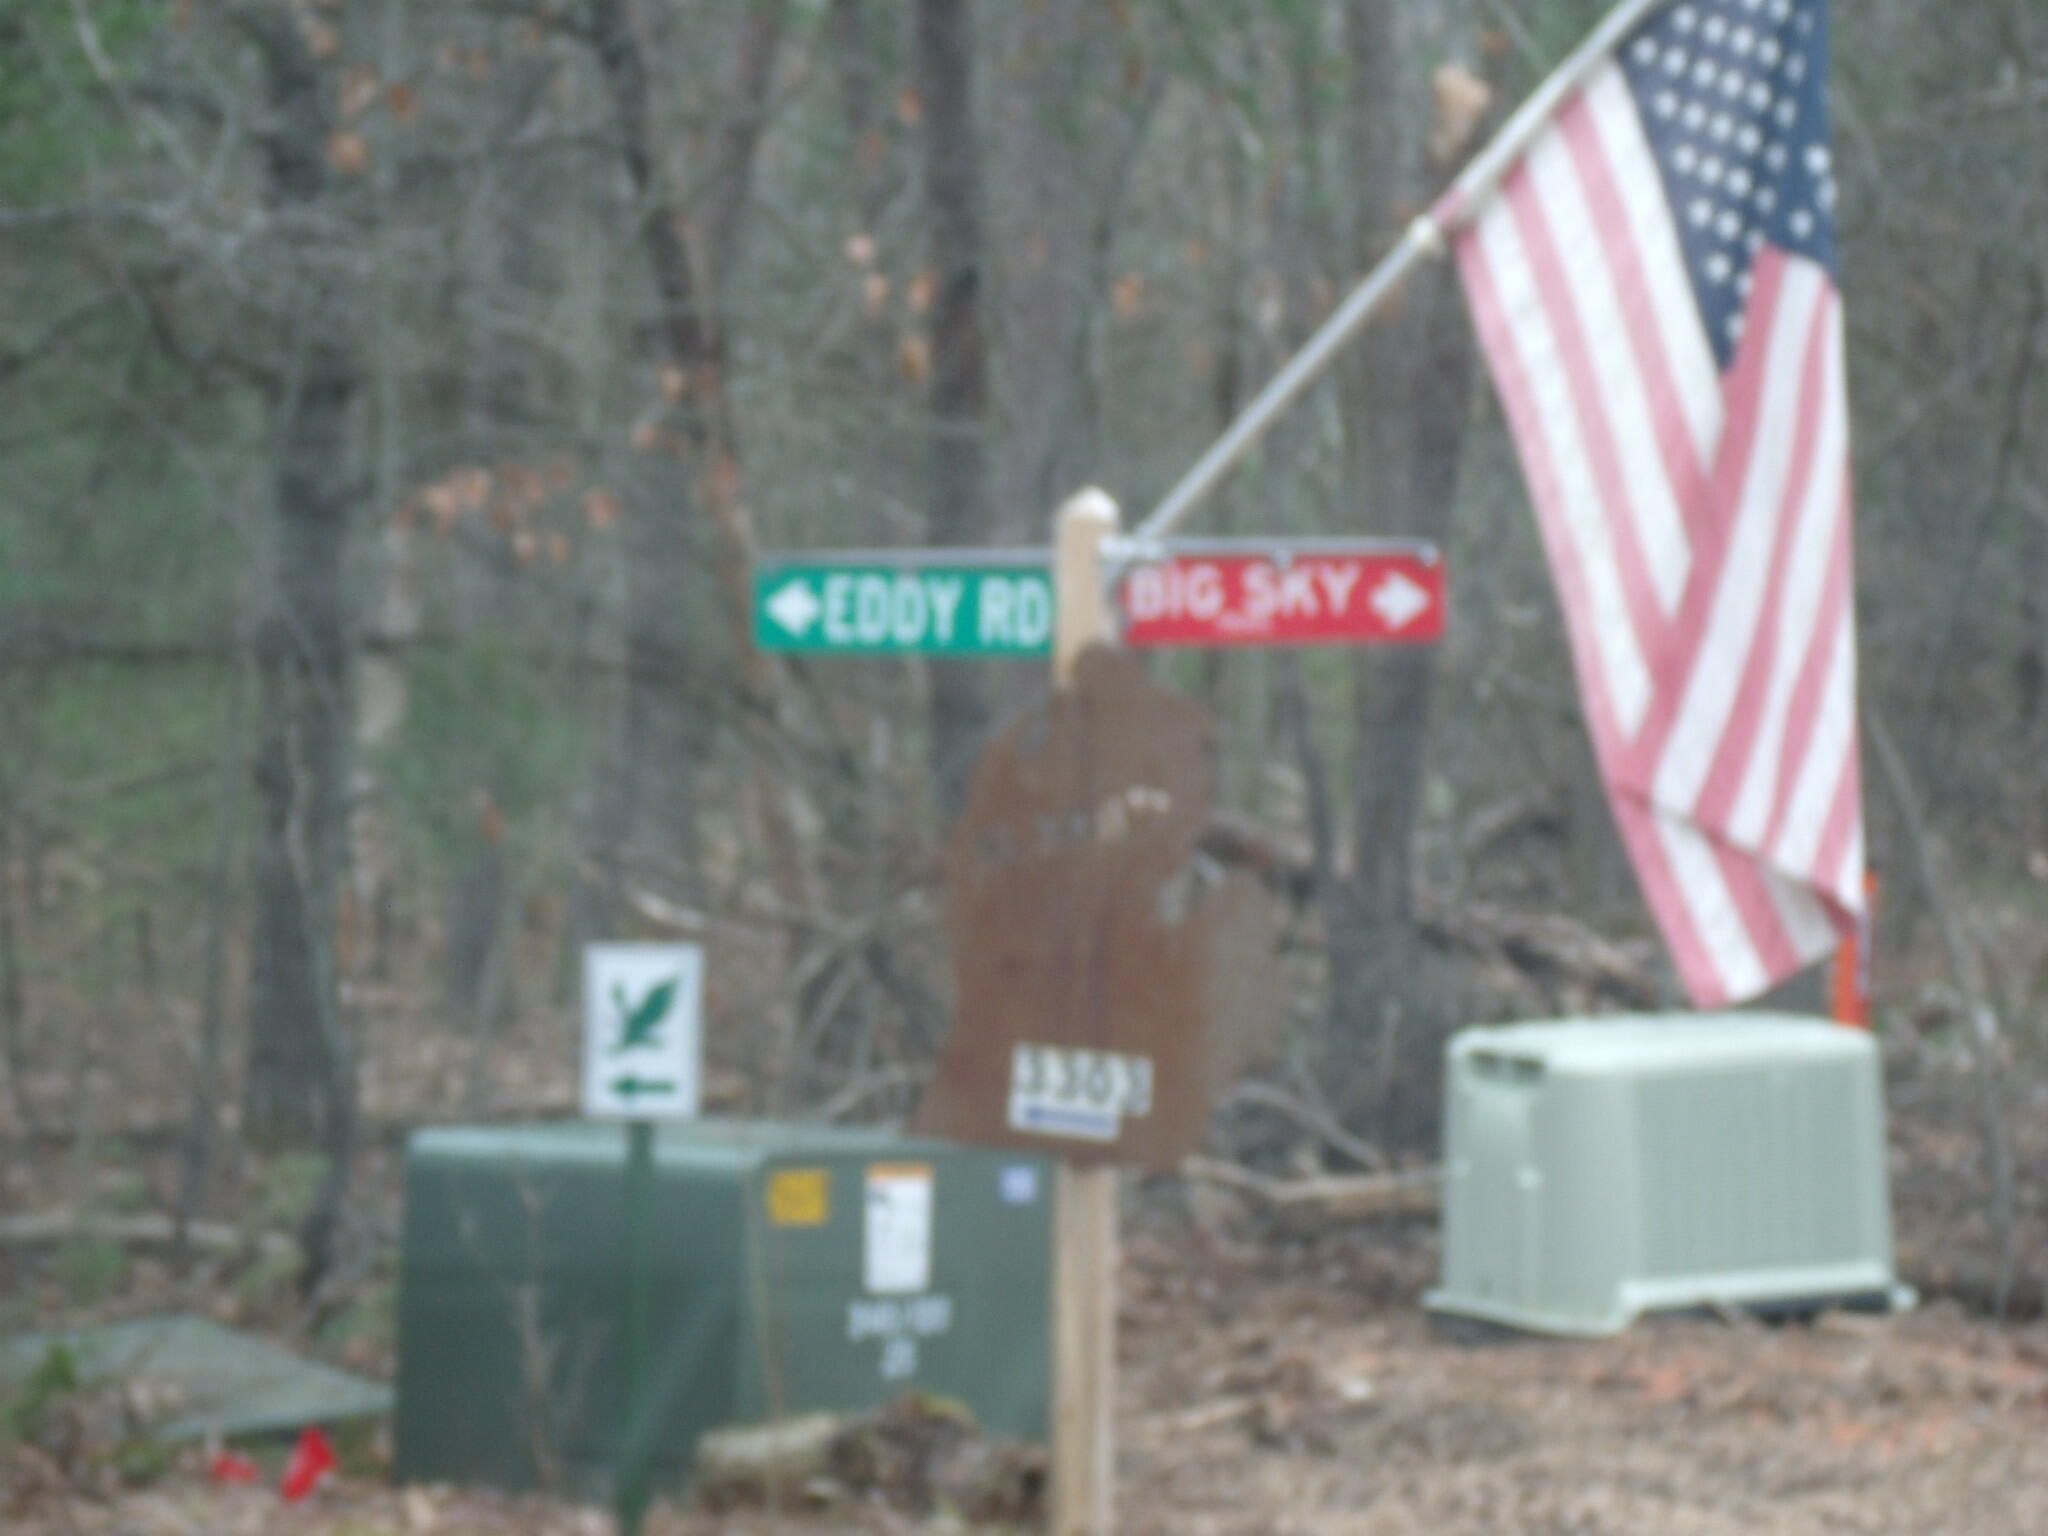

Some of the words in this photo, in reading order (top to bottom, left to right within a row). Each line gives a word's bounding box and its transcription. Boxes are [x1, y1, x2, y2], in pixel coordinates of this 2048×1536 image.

[823, 573, 963, 645] EDDY
[978, 575, 1050, 647] RD
[1128, 562, 1225, 620] BIG
[1241, 561, 1361, 619] SKY
